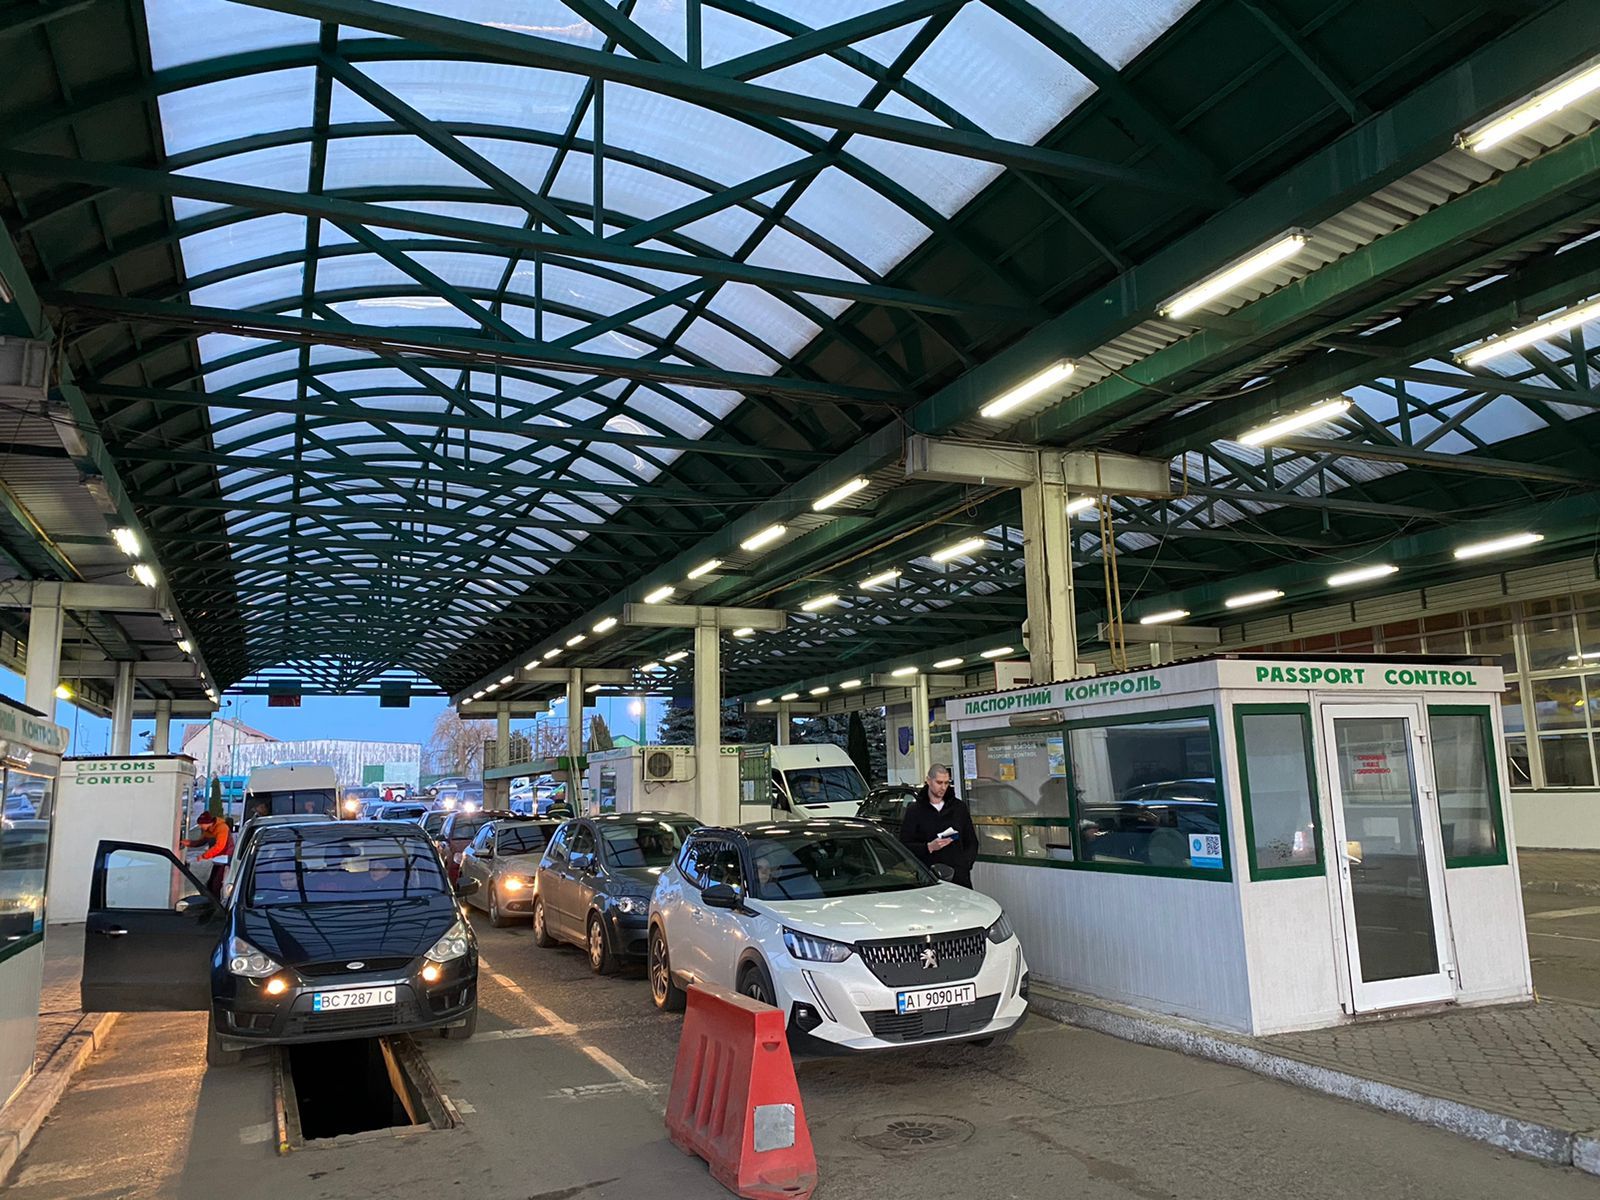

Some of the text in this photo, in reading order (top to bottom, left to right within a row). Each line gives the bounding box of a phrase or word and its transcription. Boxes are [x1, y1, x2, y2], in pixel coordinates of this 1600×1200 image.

[1255, 666, 1477, 686] PASSPORT CONTROL
[965, 675, 1161, 715] ПАСПОРТНИЙ КОНТРОЛЬ
[75, 762, 156, 771] CUSTOMS
[75, 775, 155, 785] CONTROL
[321, 990, 393, 1008] BC 7287 IC
[906, 987, 971, 1009] AI 9090 HT
